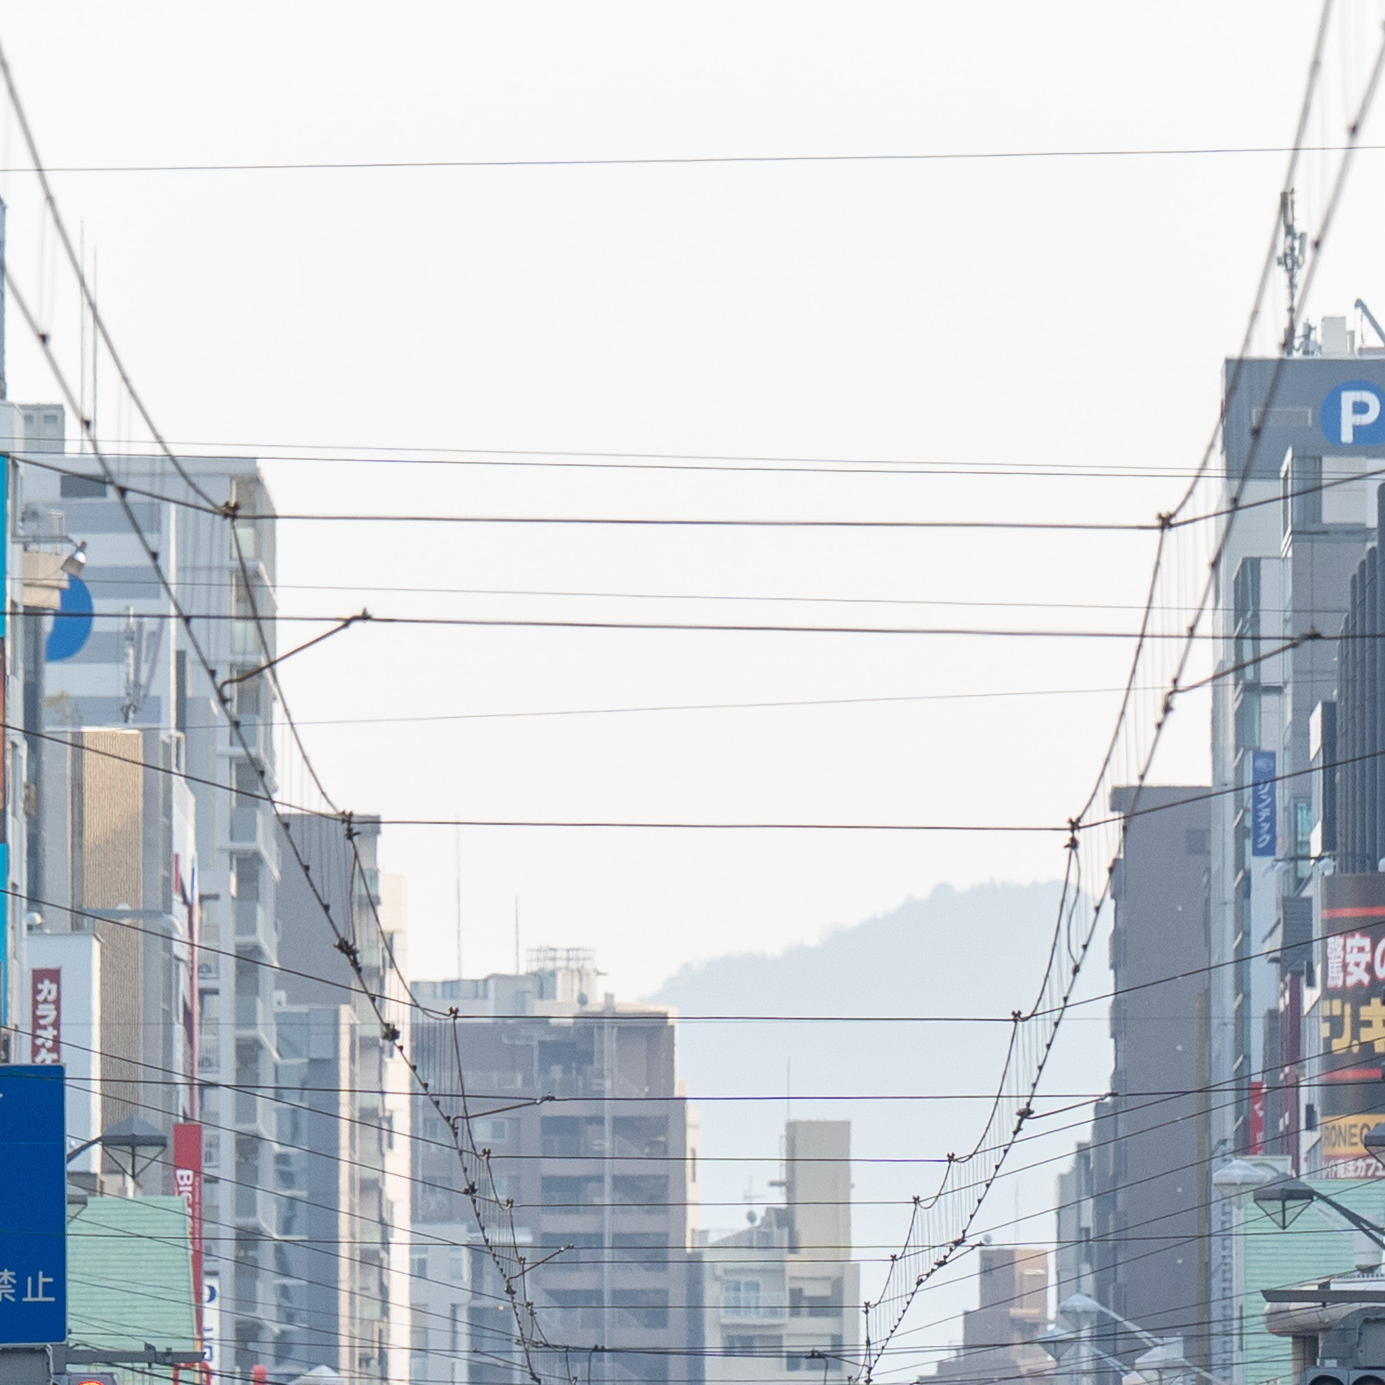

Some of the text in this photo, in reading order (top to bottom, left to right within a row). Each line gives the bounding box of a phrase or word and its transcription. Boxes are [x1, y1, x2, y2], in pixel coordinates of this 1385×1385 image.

[1340, 390, 1381, 444] P
[34, 978, 59, 1064] カラオケ
